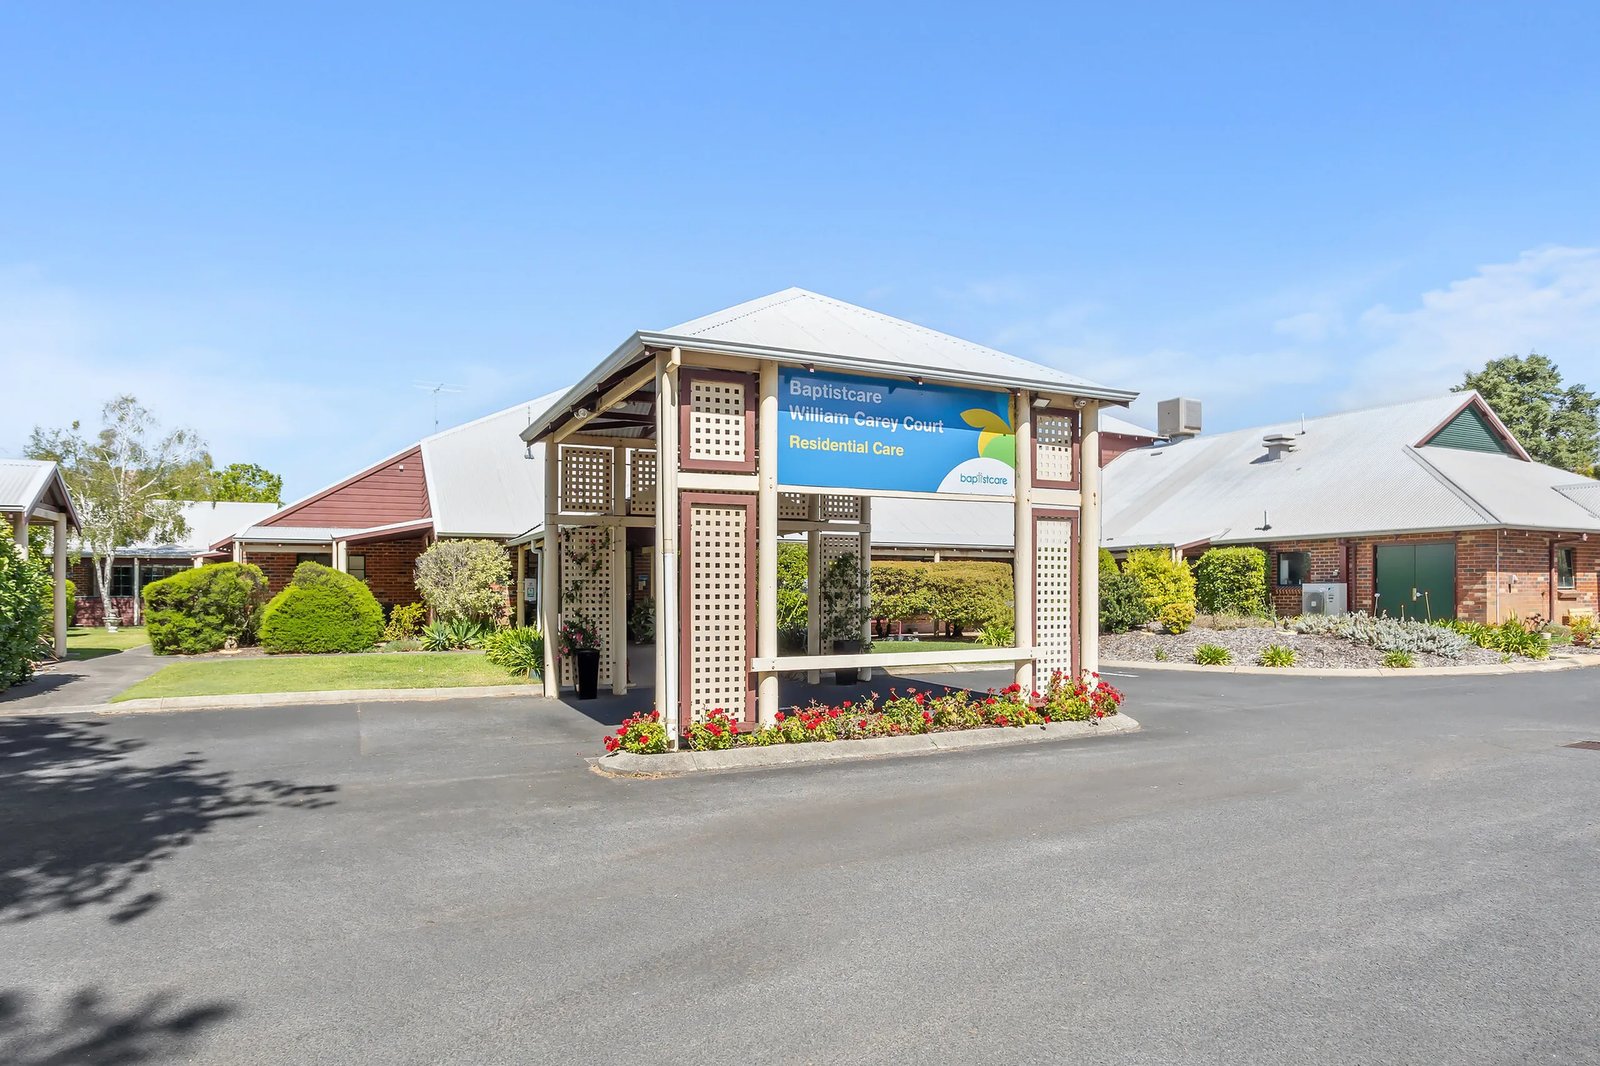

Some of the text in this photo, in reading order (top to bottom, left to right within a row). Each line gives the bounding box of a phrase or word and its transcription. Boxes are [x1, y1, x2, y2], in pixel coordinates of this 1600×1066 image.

[790, 380, 882, 404] Baptistcare
[789, 404, 944, 433] William Carey Court
[789, 435, 904, 456] Residential Care
